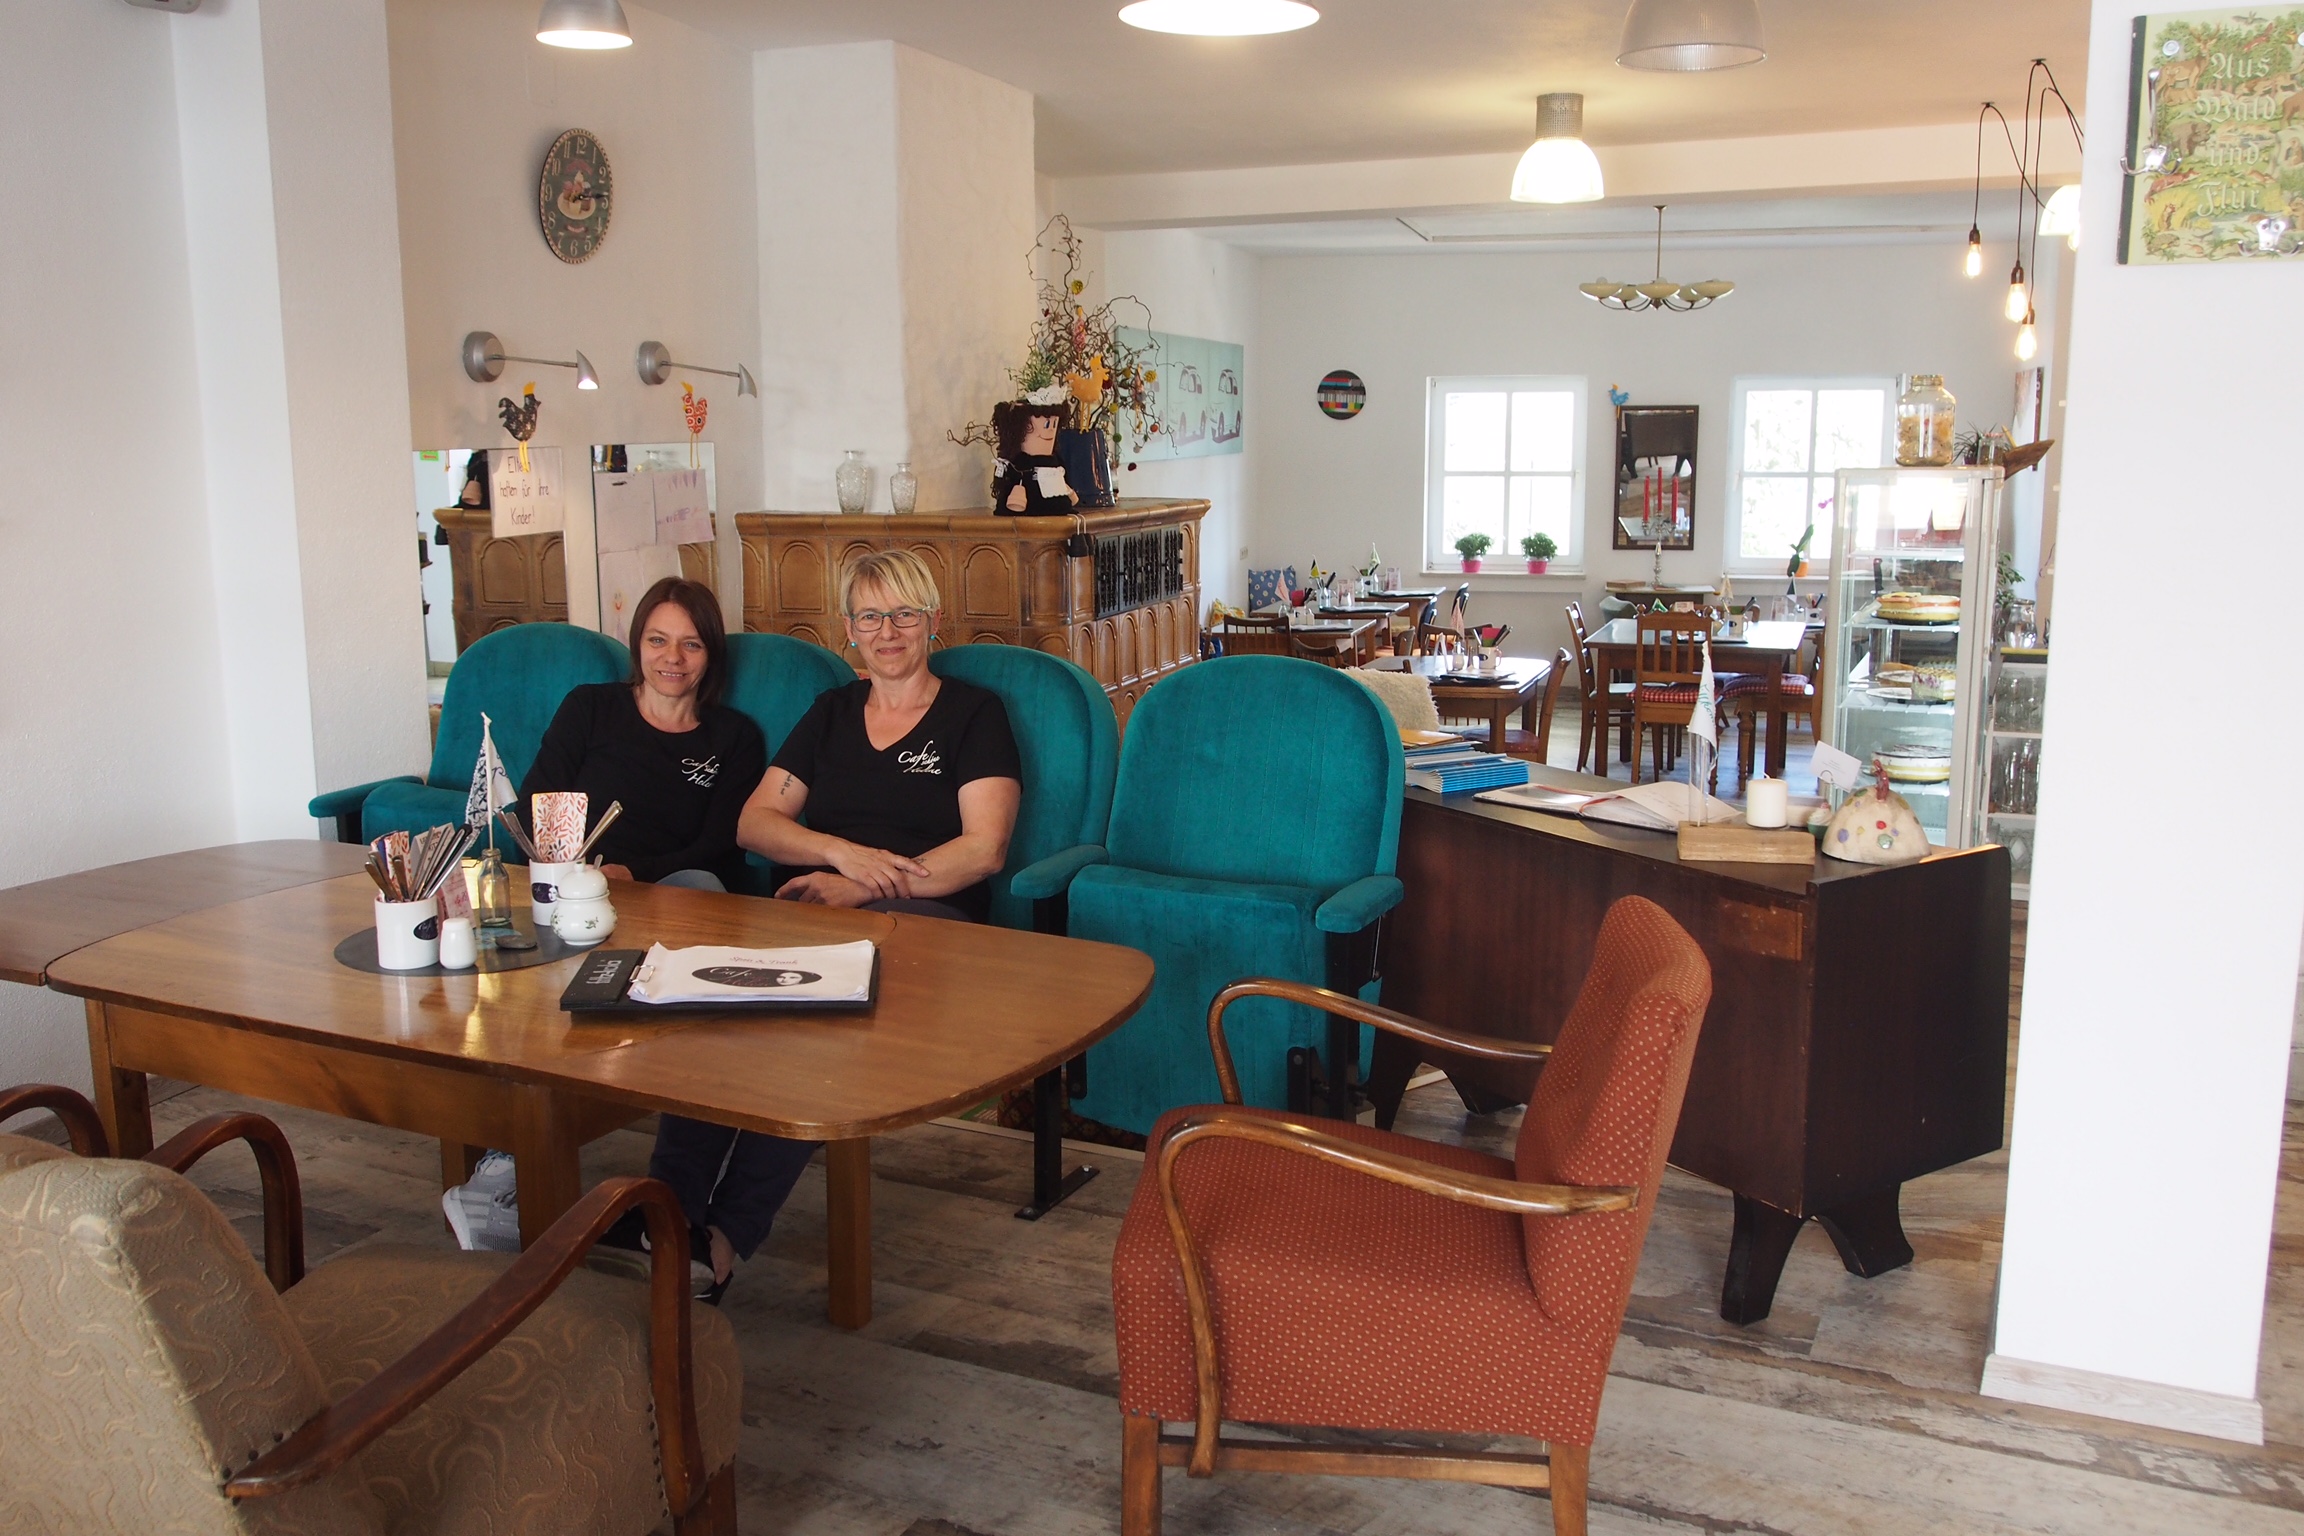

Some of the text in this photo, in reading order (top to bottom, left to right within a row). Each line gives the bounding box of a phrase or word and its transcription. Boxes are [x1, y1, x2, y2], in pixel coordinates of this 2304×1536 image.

[2210, 52, 2271, 79] Aus
[2196, 96, 2276, 124] Wald
[564, 141, 571, 158] 11
[577, 137, 587, 155] 12
[2207, 142, 2260, 167] und
[552, 159, 561, 176] 10
[599, 167, 607, 184] 2
[545, 184, 552, 201] 9
[2196, 181, 2260, 217] Flur
[548, 212, 556, 229] 8
[594, 217, 602, 234] 4
[559, 232, 565, 249] 7
[570, 240, 578, 256] 6
[584, 236, 592, 251] 5
[510, 505, 536, 525] Kinder!
